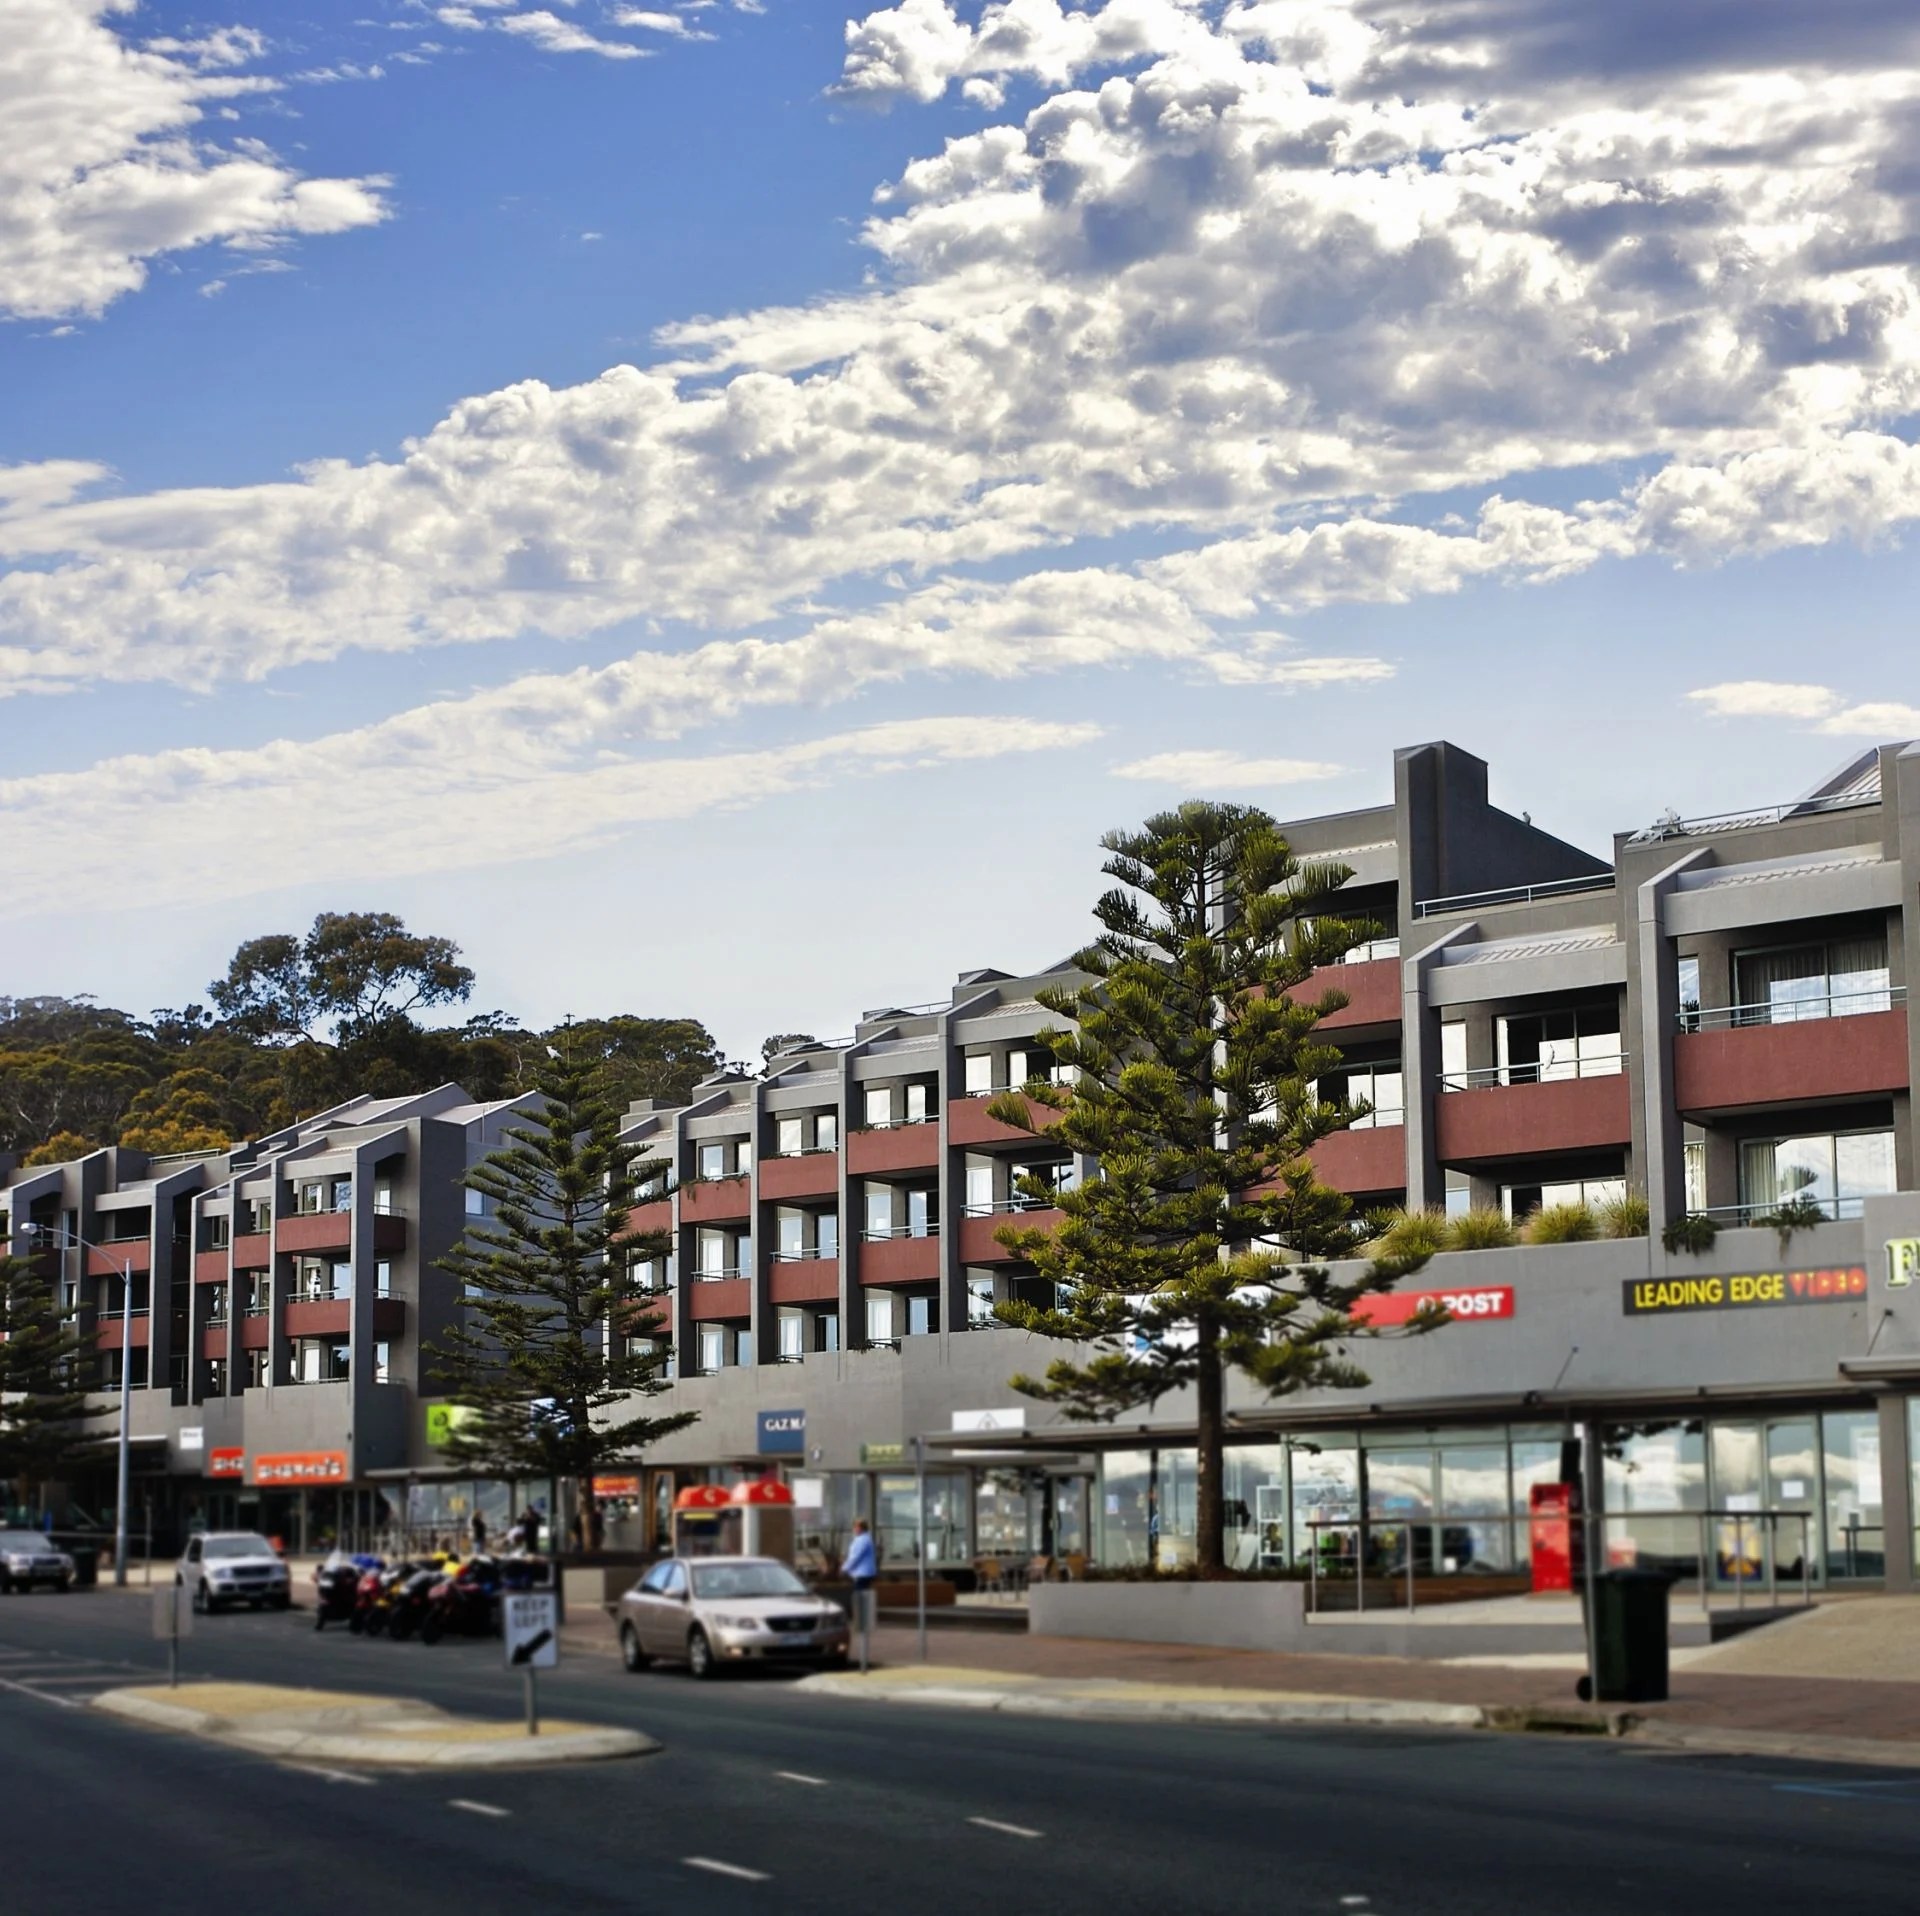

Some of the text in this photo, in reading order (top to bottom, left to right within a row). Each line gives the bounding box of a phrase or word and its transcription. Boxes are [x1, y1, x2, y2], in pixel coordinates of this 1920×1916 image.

[1441, 1291, 1504, 1315] POST
[1634, 1267, 1868, 1308] LEADING EDGE VIDEO
